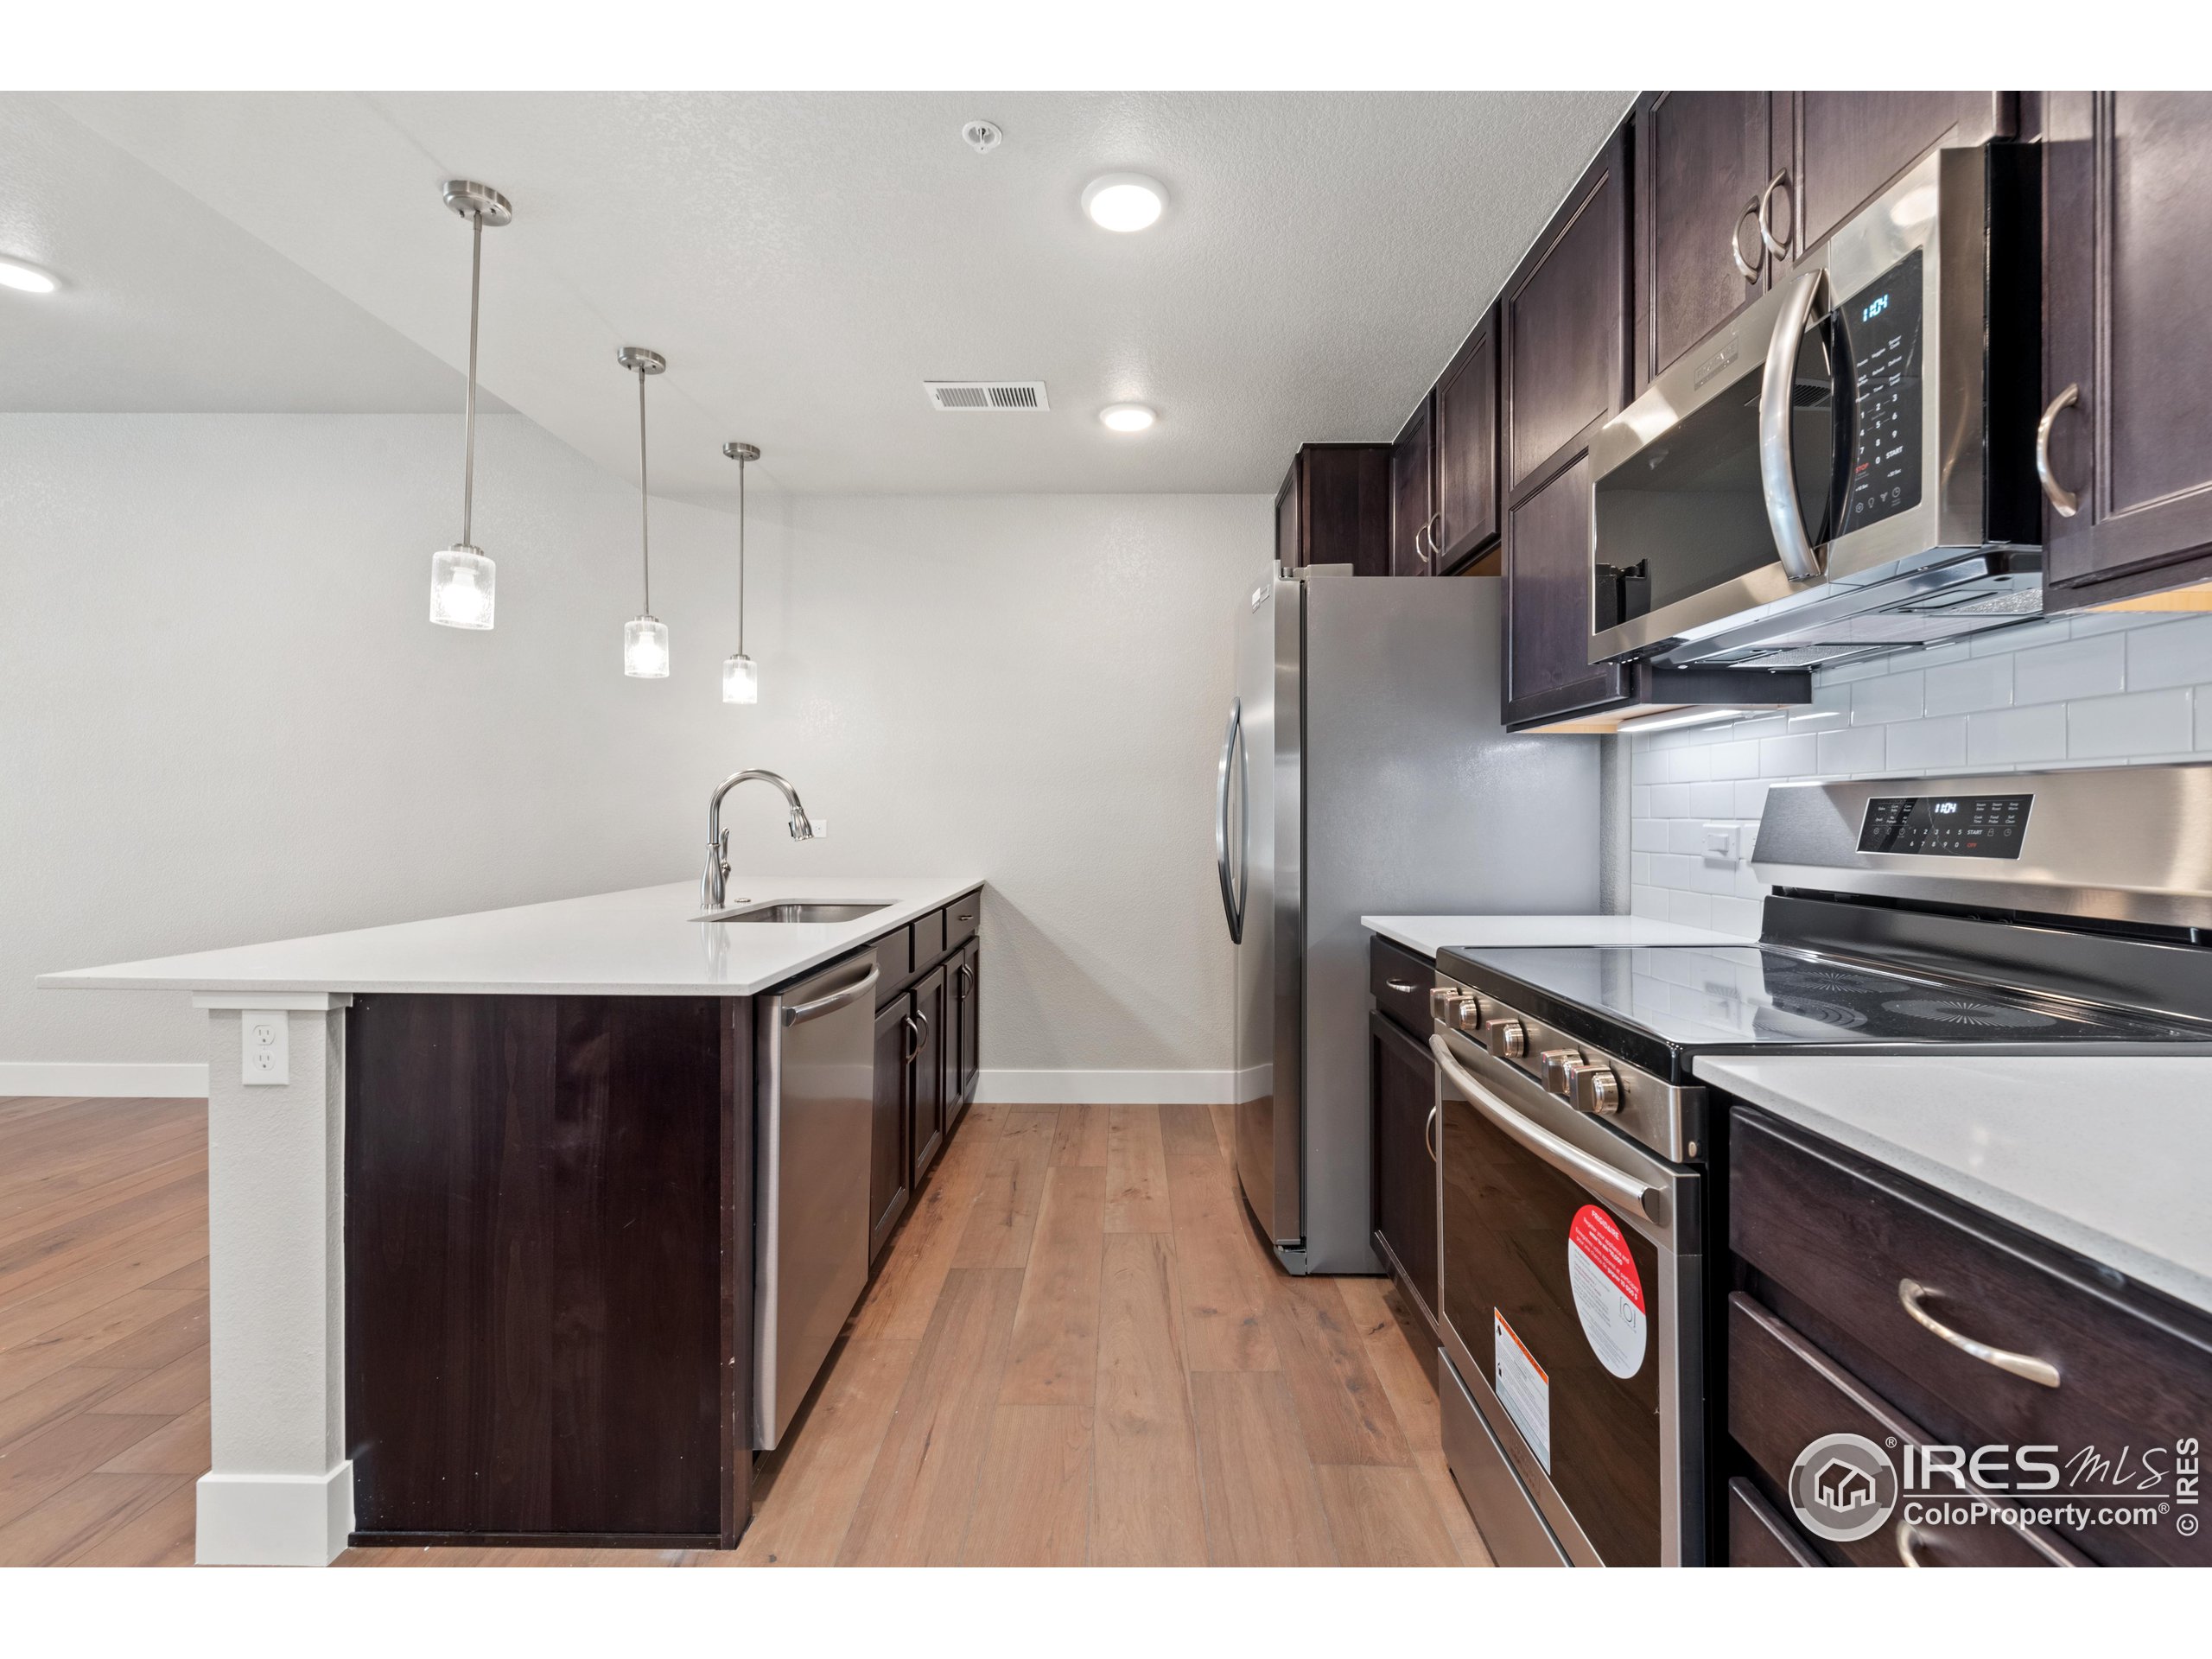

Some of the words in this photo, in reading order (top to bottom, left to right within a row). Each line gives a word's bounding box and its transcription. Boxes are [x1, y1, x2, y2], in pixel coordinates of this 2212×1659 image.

[1876, 403, 1881, 411] 2
[1886, 445, 1904, 459] START
[1855, 463, 1869, 474] STOP
[1592, 1210, 1619, 1240] FRIGIDAIRE
